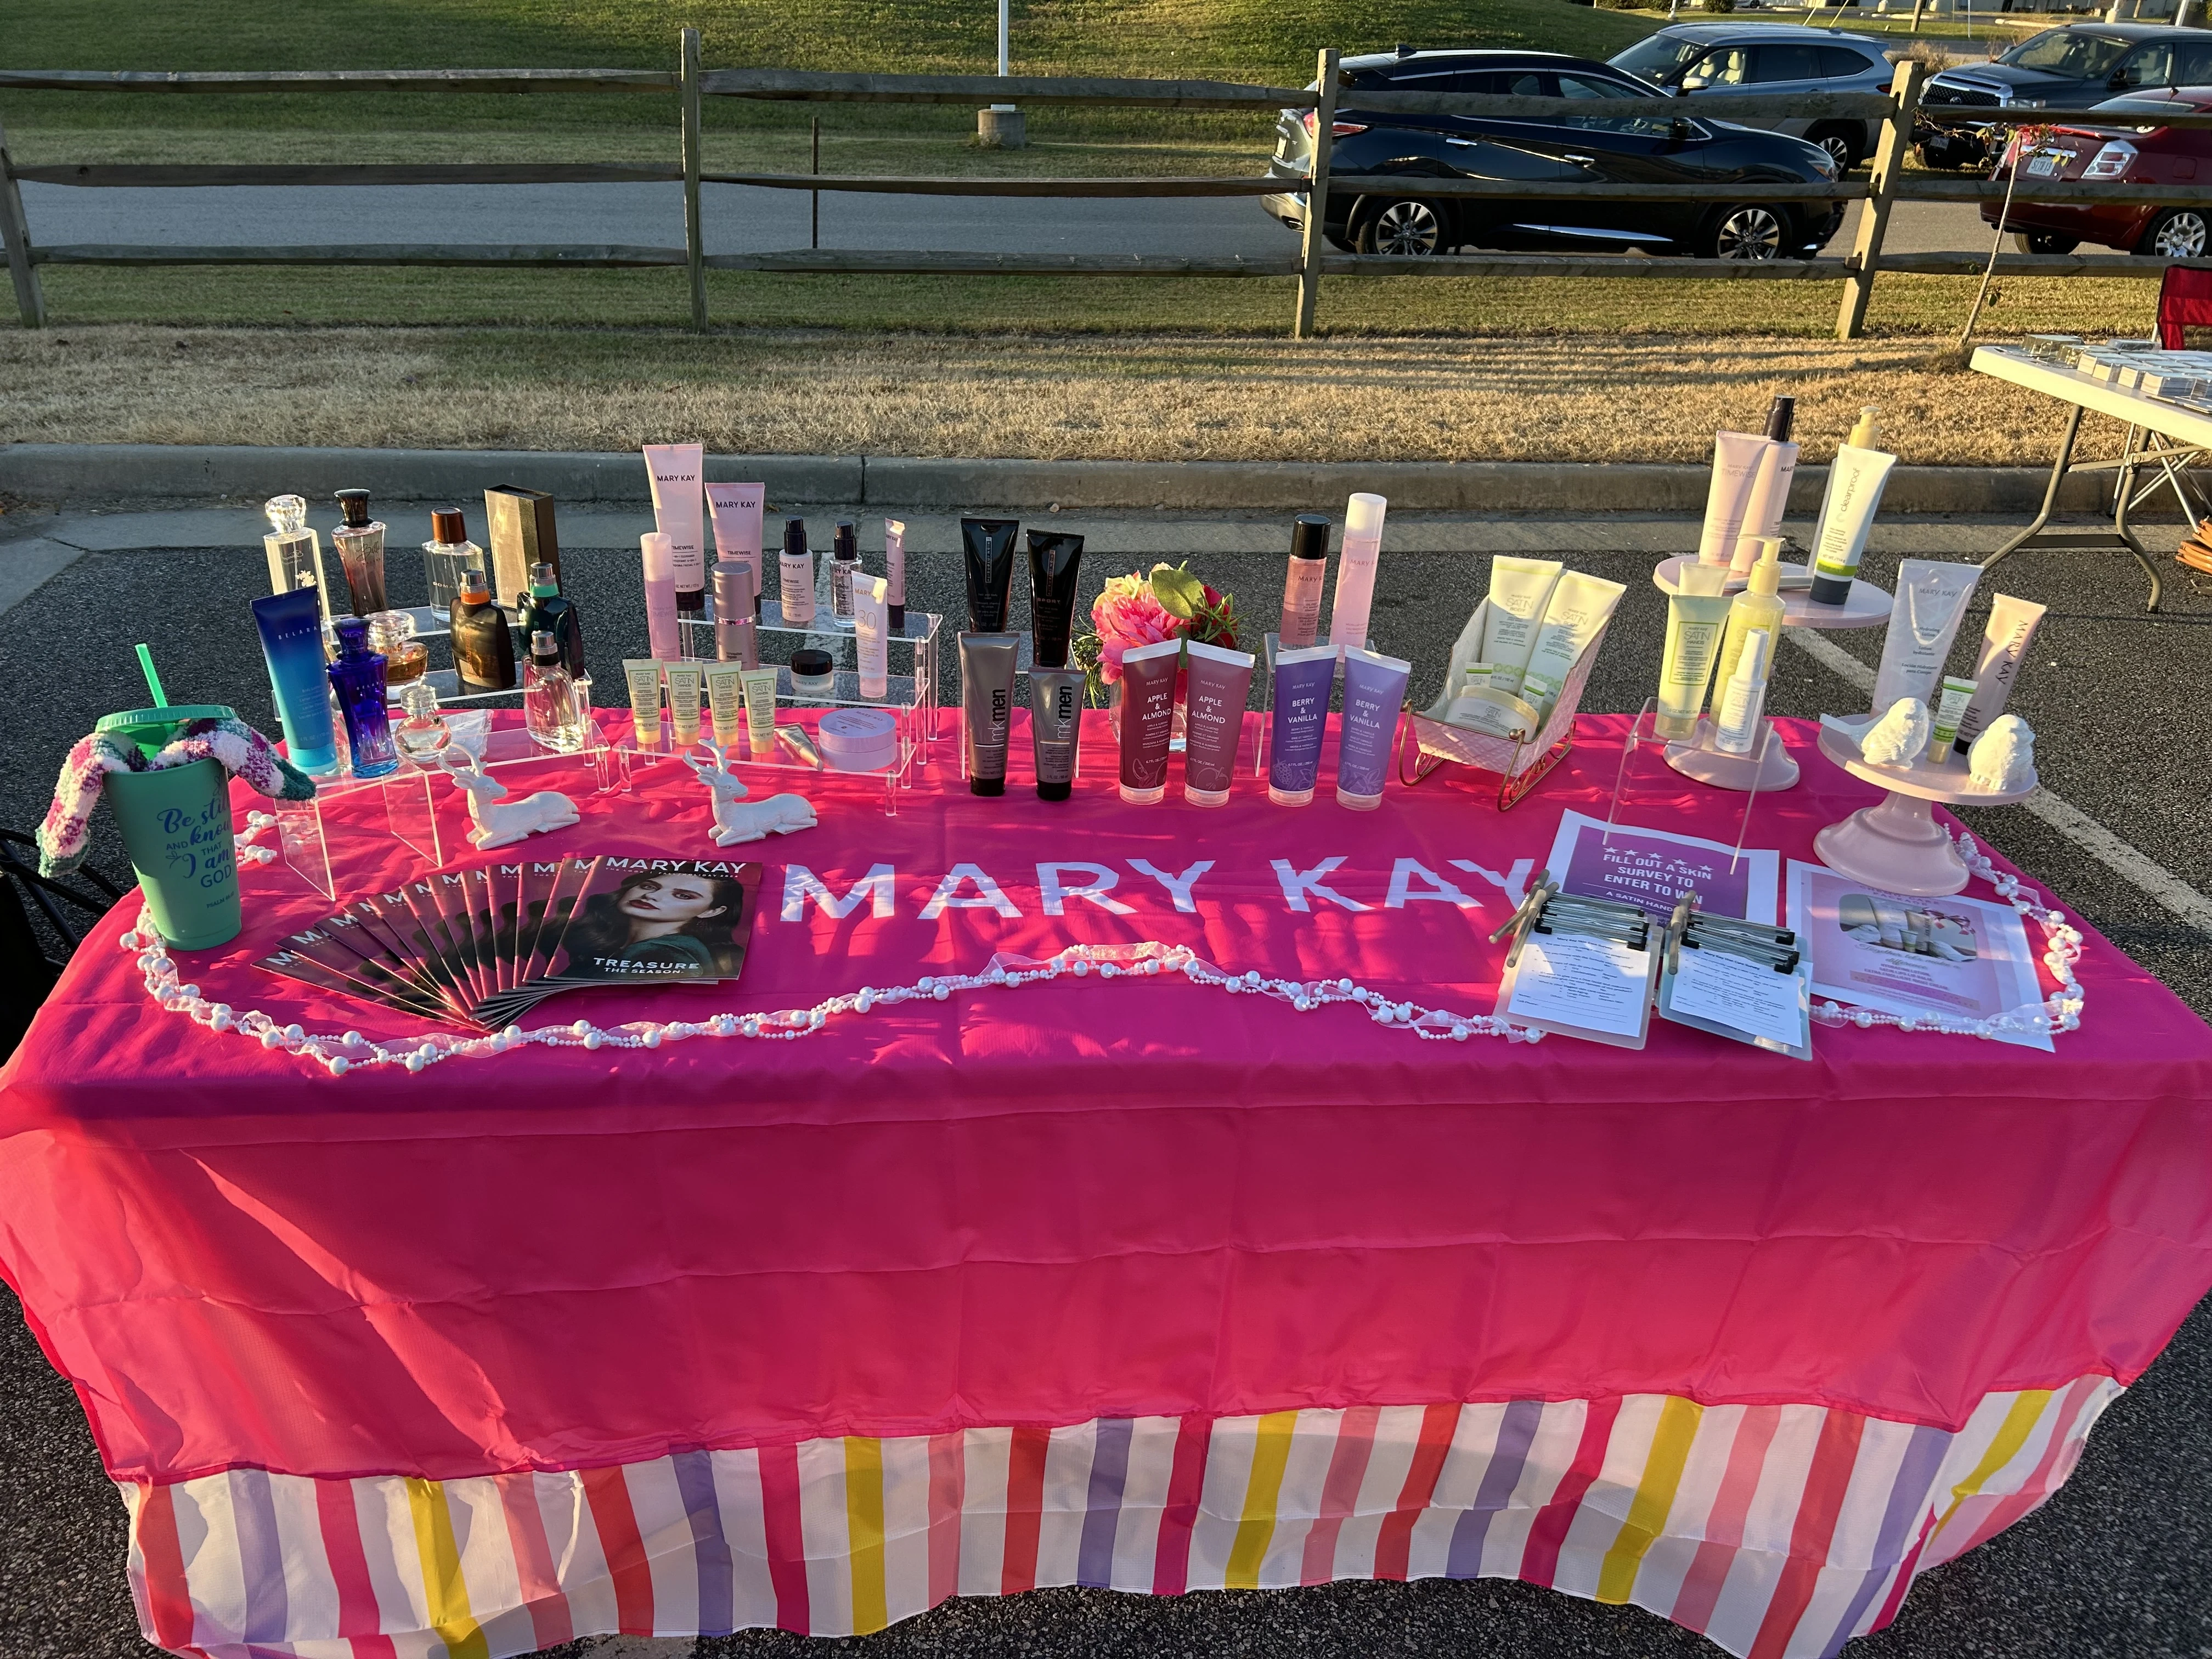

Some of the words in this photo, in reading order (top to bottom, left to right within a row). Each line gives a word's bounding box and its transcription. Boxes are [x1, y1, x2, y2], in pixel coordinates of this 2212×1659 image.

[1722, 468, 1755, 478] TIMEWISE
[1841, 467, 1860, 512] clearproof
[855, 588, 871, 596] MARY
[1505, 597, 1534, 610] SATIN
[858, 610, 876, 630] 30
[1561, 611, 1589, 625] SATIN
[278, 626, 318, 640] BELARA
[1684, 631, 1710, 641] SATIN
[2007, 620, 2029, 658] MARY
[1996, 661, 2013, 685] KAY
[715, 678, 735, 686] SATIN
[1147, 692, 1167, 703] APPLE
[1198, 696, 1222, 707] APPLE
[1292, 697, 1315, 707] BERRY
[1054, 686, 1073, 739] mkmen
[1355, 699, 1380, 712] BERRY
[987, 689, 1006, 742] mkmen
[1142, 708, 1171, 721] ALMOND
[1191, 710, 1226, 724] ALMOND
[1288, 713, 1317, 724] VANILLA
[1350, 714, 1380, 729] VANILLA
[157, 808, 195, 834] Be
[166, 841, 188, 850] AND
[201, 841, 222, 855] THAT
[182, 853, 196, 878] I
[205, 848, 230, 868] am
[606, 857, 688, 871] MARY
[694, 861, 747, 873] KAY
[1603, 854, 1631, 865] FILL
[1635, 857, 1663, 868] OUT
[1679, 867, 1712, 880] SKIN
[200, 865, 232, 888] GOD
[1617, 867, 1672, 882] SURVEY
[1676, 876, 1694, 888] TO
[780, 859, 1216, 922] MARY
[1269, 856, 1534, 912] KAY
[1604, 874, 1649, 890] ENTER
[1654, 883, 1671, 896] TO
[1675, 889, 1703, 904] WN
[206, 898, 225, 909] PSALM
[1615, 893, 1644, 904] SATIN
[1645, 901, 1673, 912] HAND
[1873, 891, 1927, 906] PACKAGE
[594, 958, 700, 969] TREASURE
